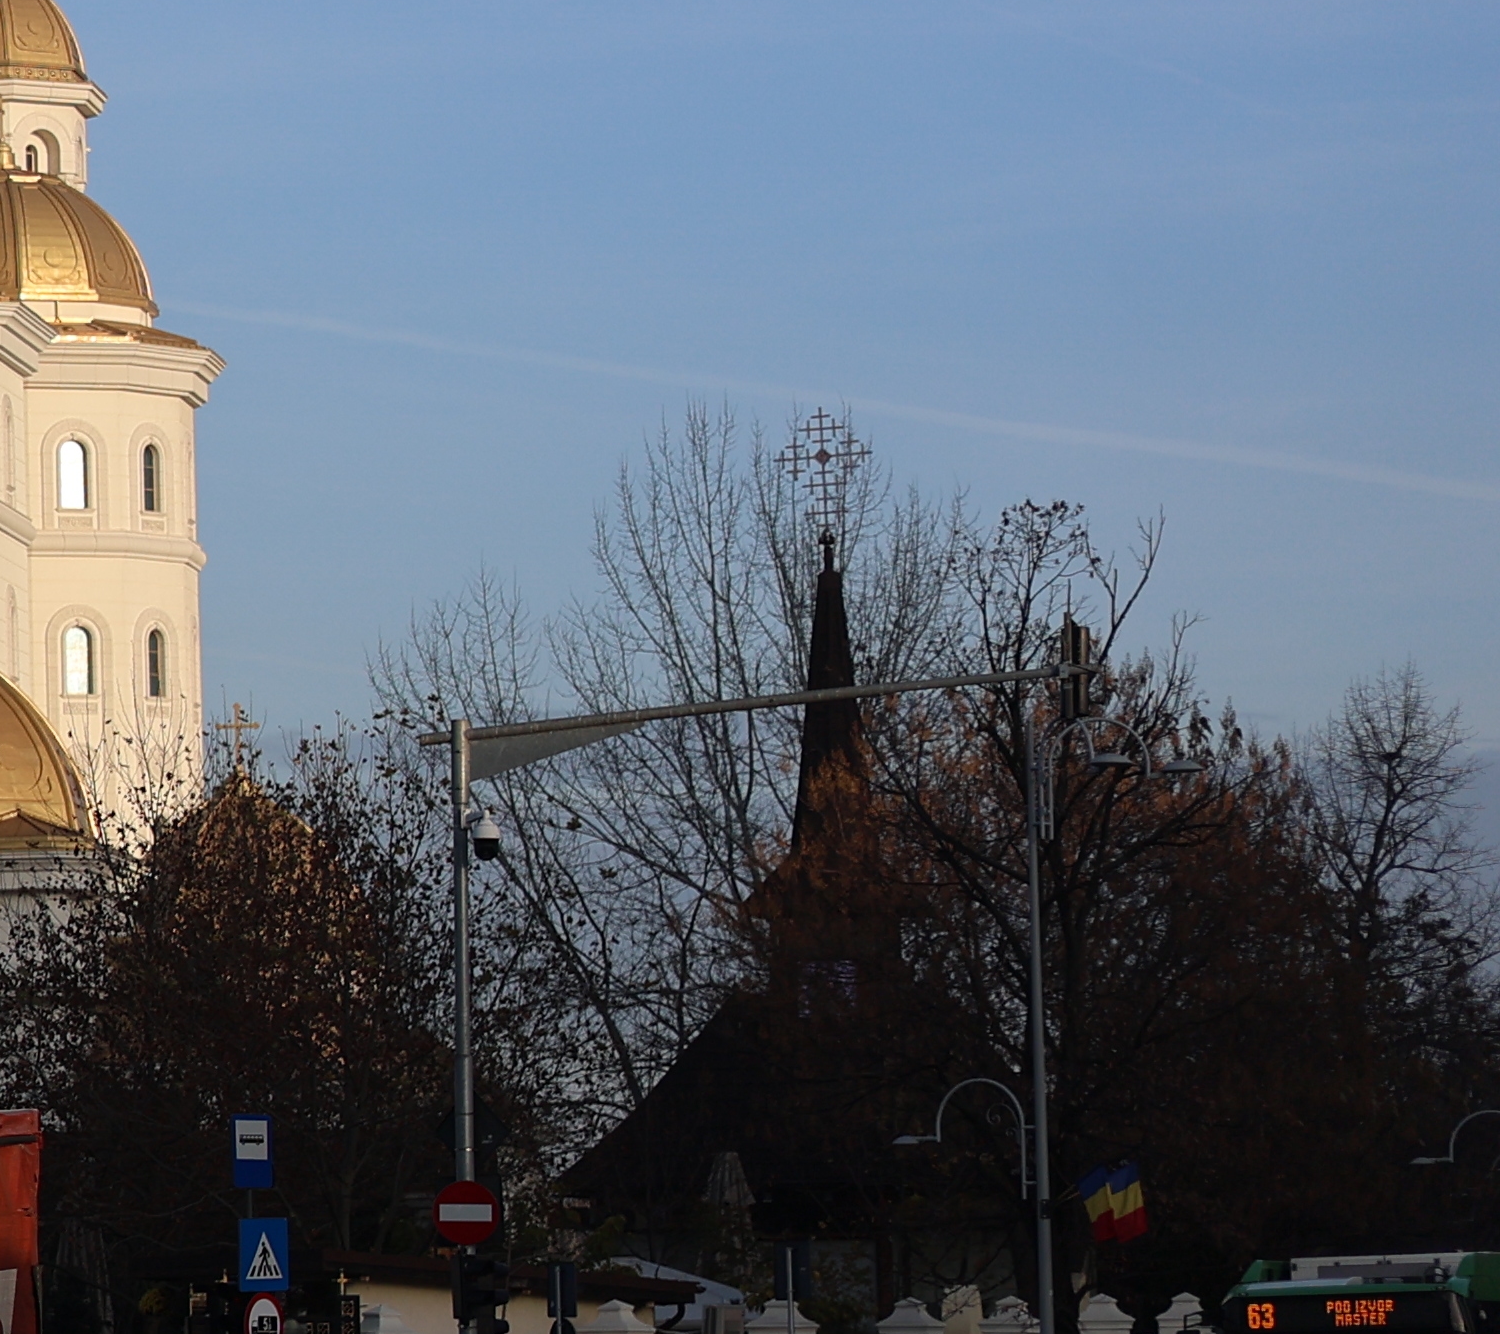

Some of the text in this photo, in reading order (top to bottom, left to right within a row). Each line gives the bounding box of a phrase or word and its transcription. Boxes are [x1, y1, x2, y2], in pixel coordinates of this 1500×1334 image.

[1326, 1299, 1394, 1314] POD IZVOR
[1247, 1303, 1275, 1329] 63
[1335, 1313, 1387, 1327] MASTER
